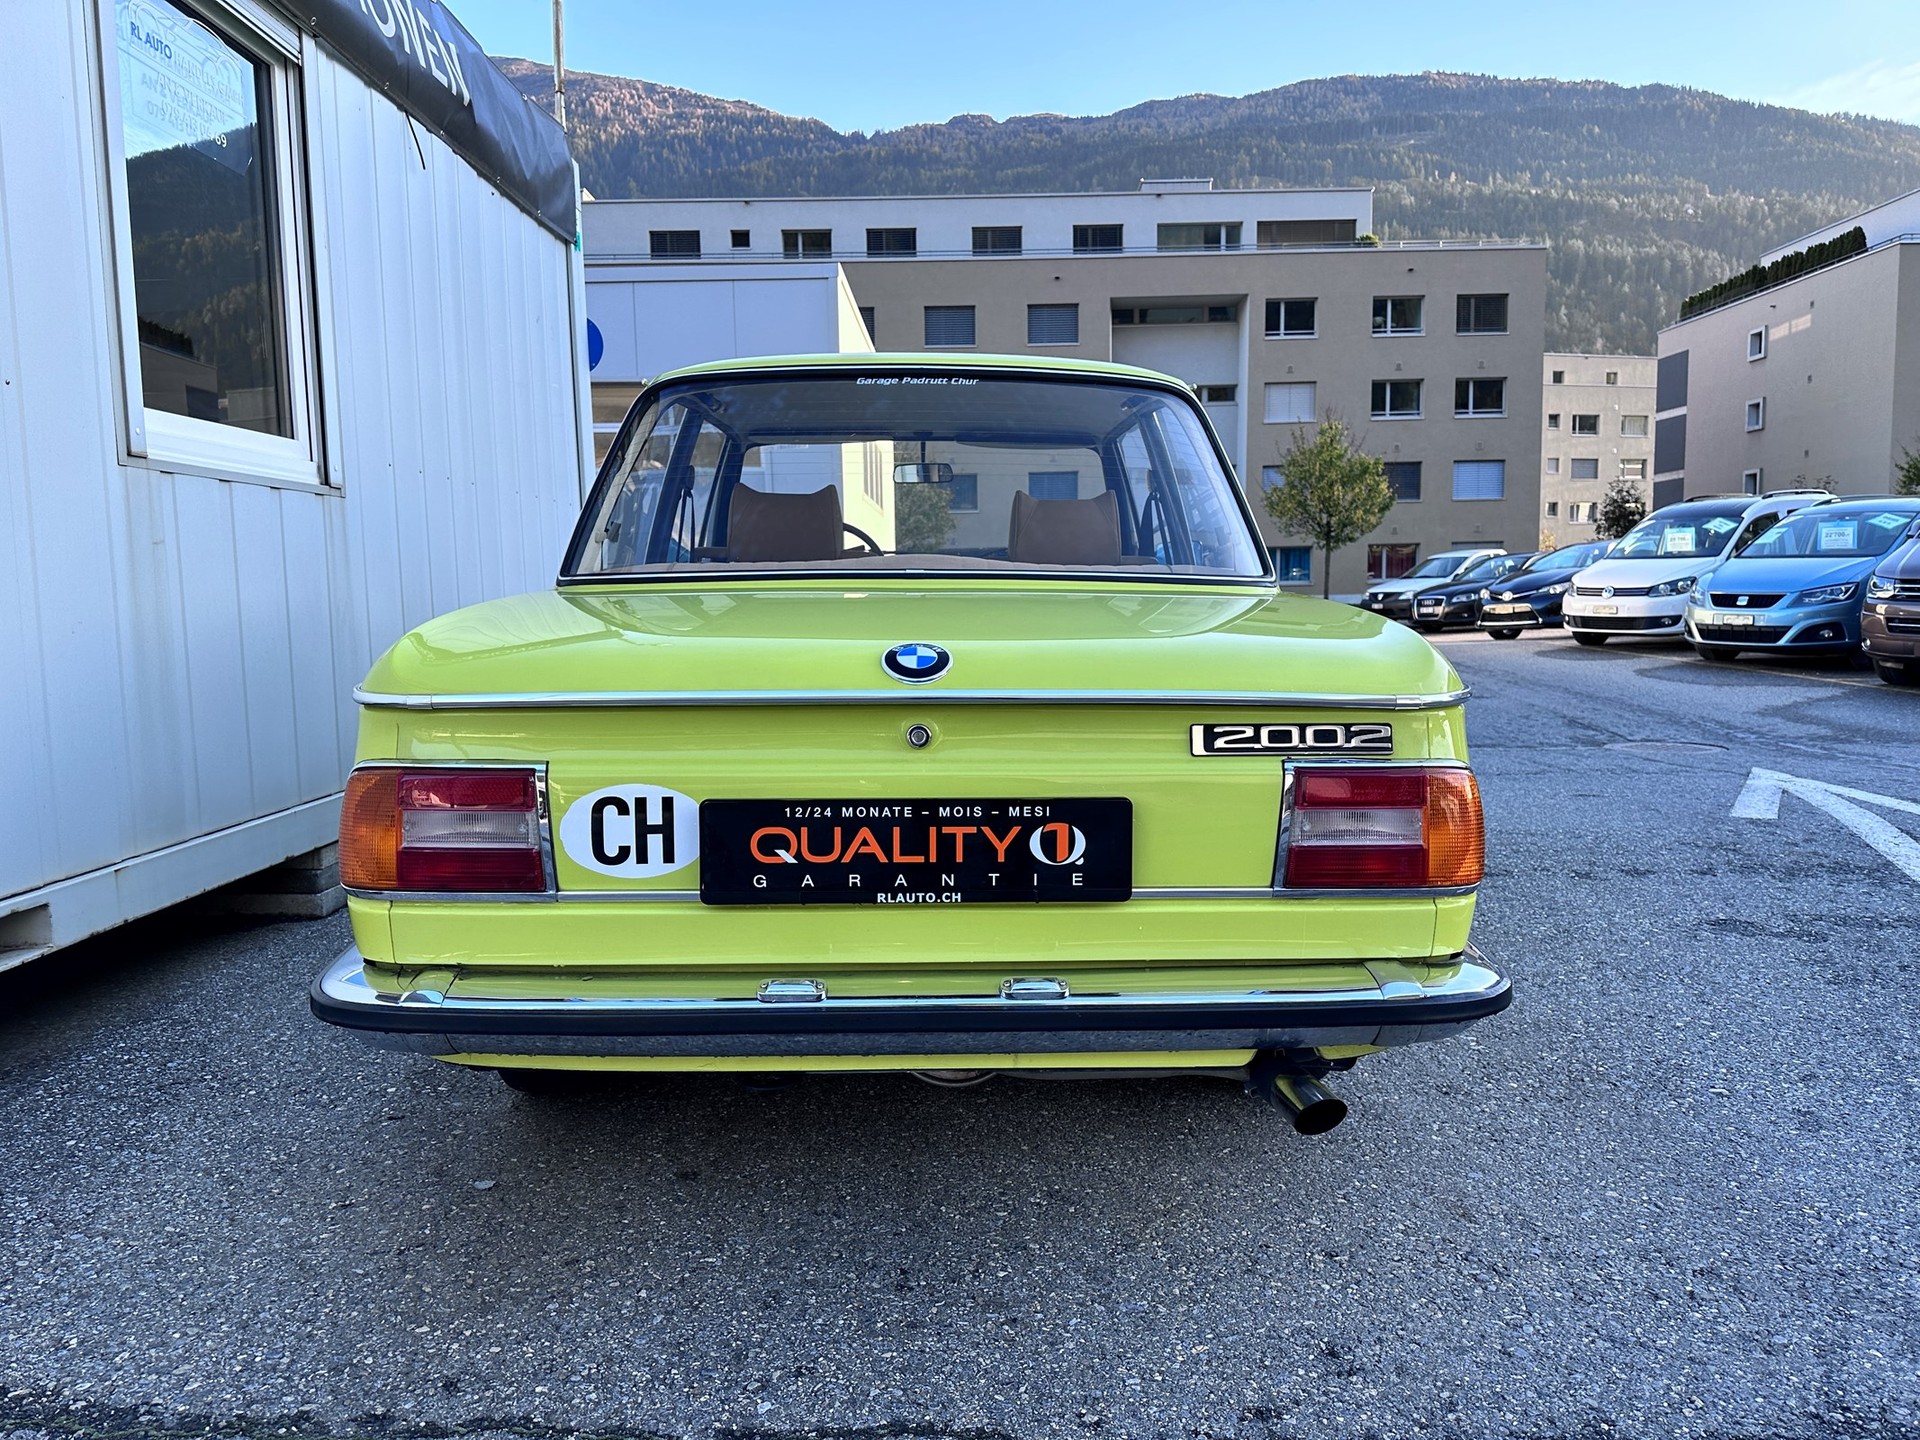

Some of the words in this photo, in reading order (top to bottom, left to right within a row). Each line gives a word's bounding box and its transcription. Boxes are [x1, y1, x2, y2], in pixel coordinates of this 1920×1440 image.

[130, 21, 142, 41] RL
[144, 32, 172, 59] AUTO
[360, 0, 470, 107] ONEN
[856, 377, 899, 386] Garage
[901, 377, 948, 385] Padrutt
[951, 378, 979, 386] Chur
[1213, 725, 1392, 749] 2002
[784, 806, 832, 819] 12/24
[841, 806, 913, 818] MONATE
[939, 806, 983, 818] MOIS
[1008, 806, 1050, 818] MESI
[591, 796, 675, 866] CH
[750, 826, 1022, 864] QUALITY
[753, 874, 1084, 888] GARANTIE
[877, 892, 962, 903] RLAUTO.CH
